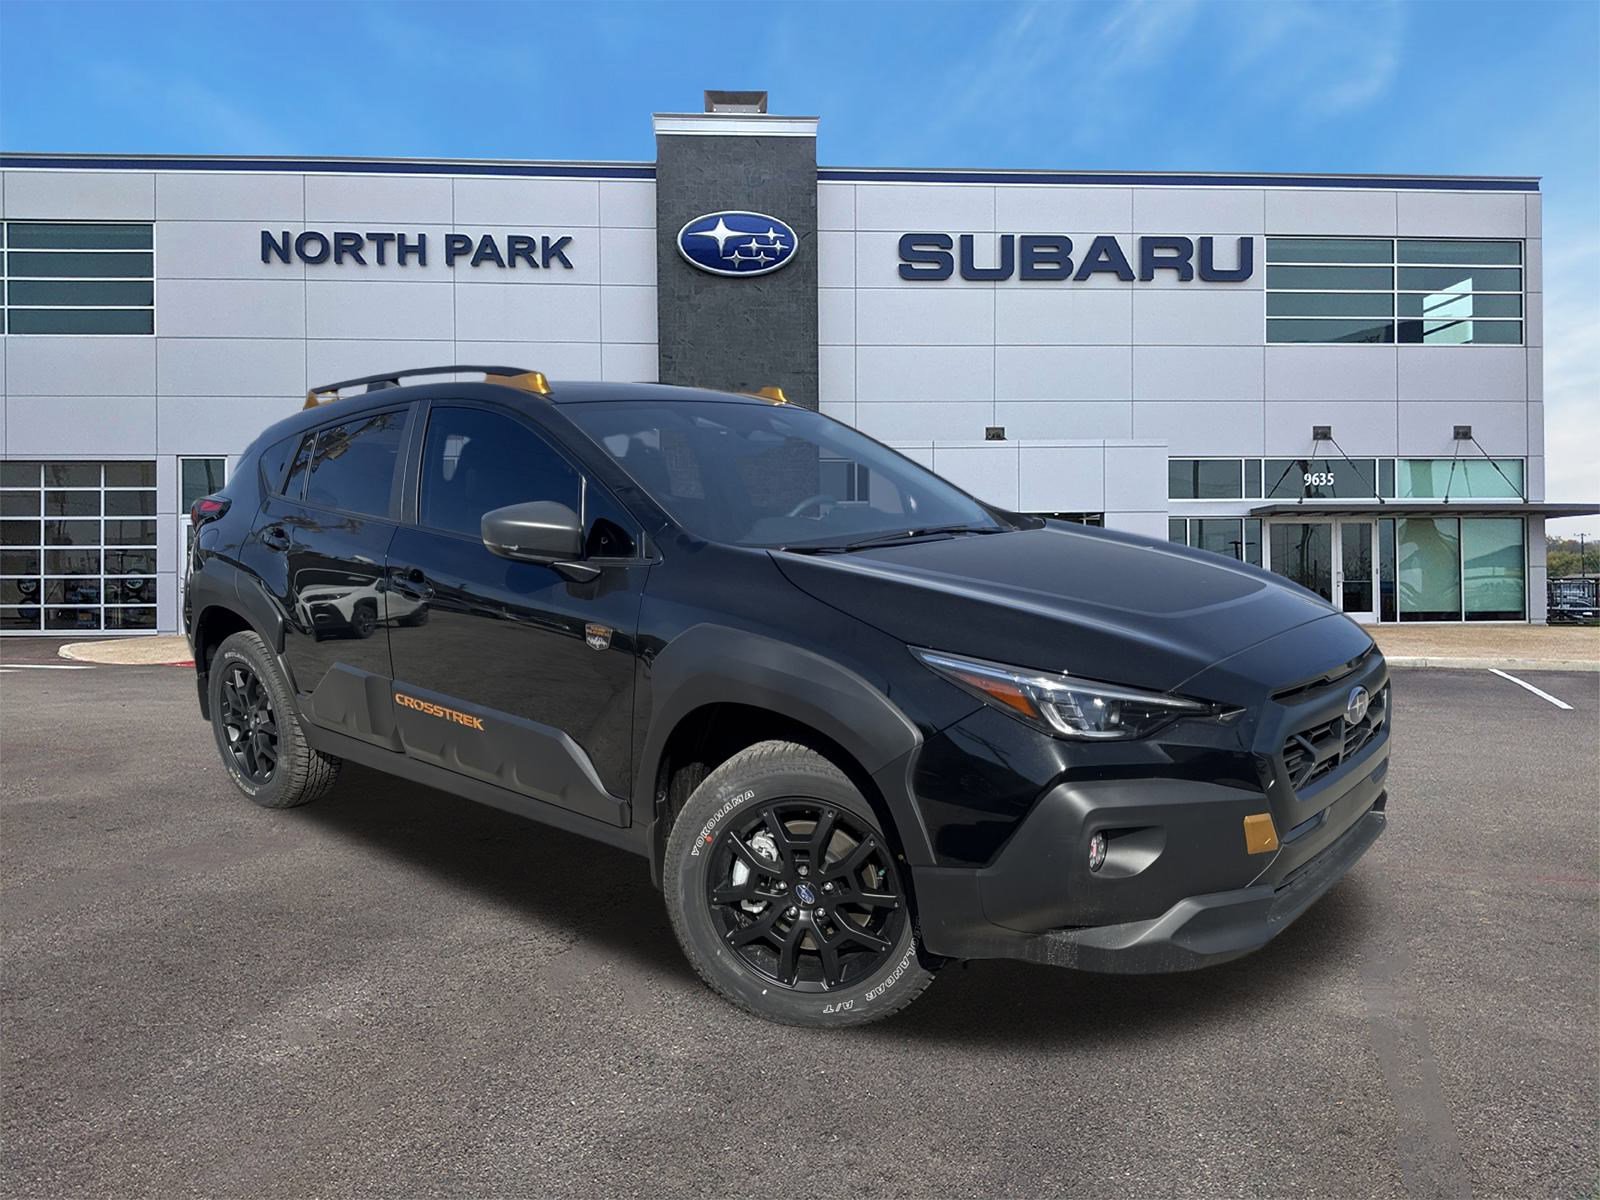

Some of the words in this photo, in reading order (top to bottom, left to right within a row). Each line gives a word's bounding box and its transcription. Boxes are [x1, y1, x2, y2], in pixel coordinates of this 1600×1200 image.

[261, 230, 427, 266] NORTH
[445, 233, 574, 269] PARK
[898, 233, 1254, 282] SUBARU
[1303, 472, 1335, 486] 9635
[394, 693, 485, 731] CROSSTREK
[691, 790, 755, 856] YOKOHAMA
[822, 999, 854, 1014] A/T
